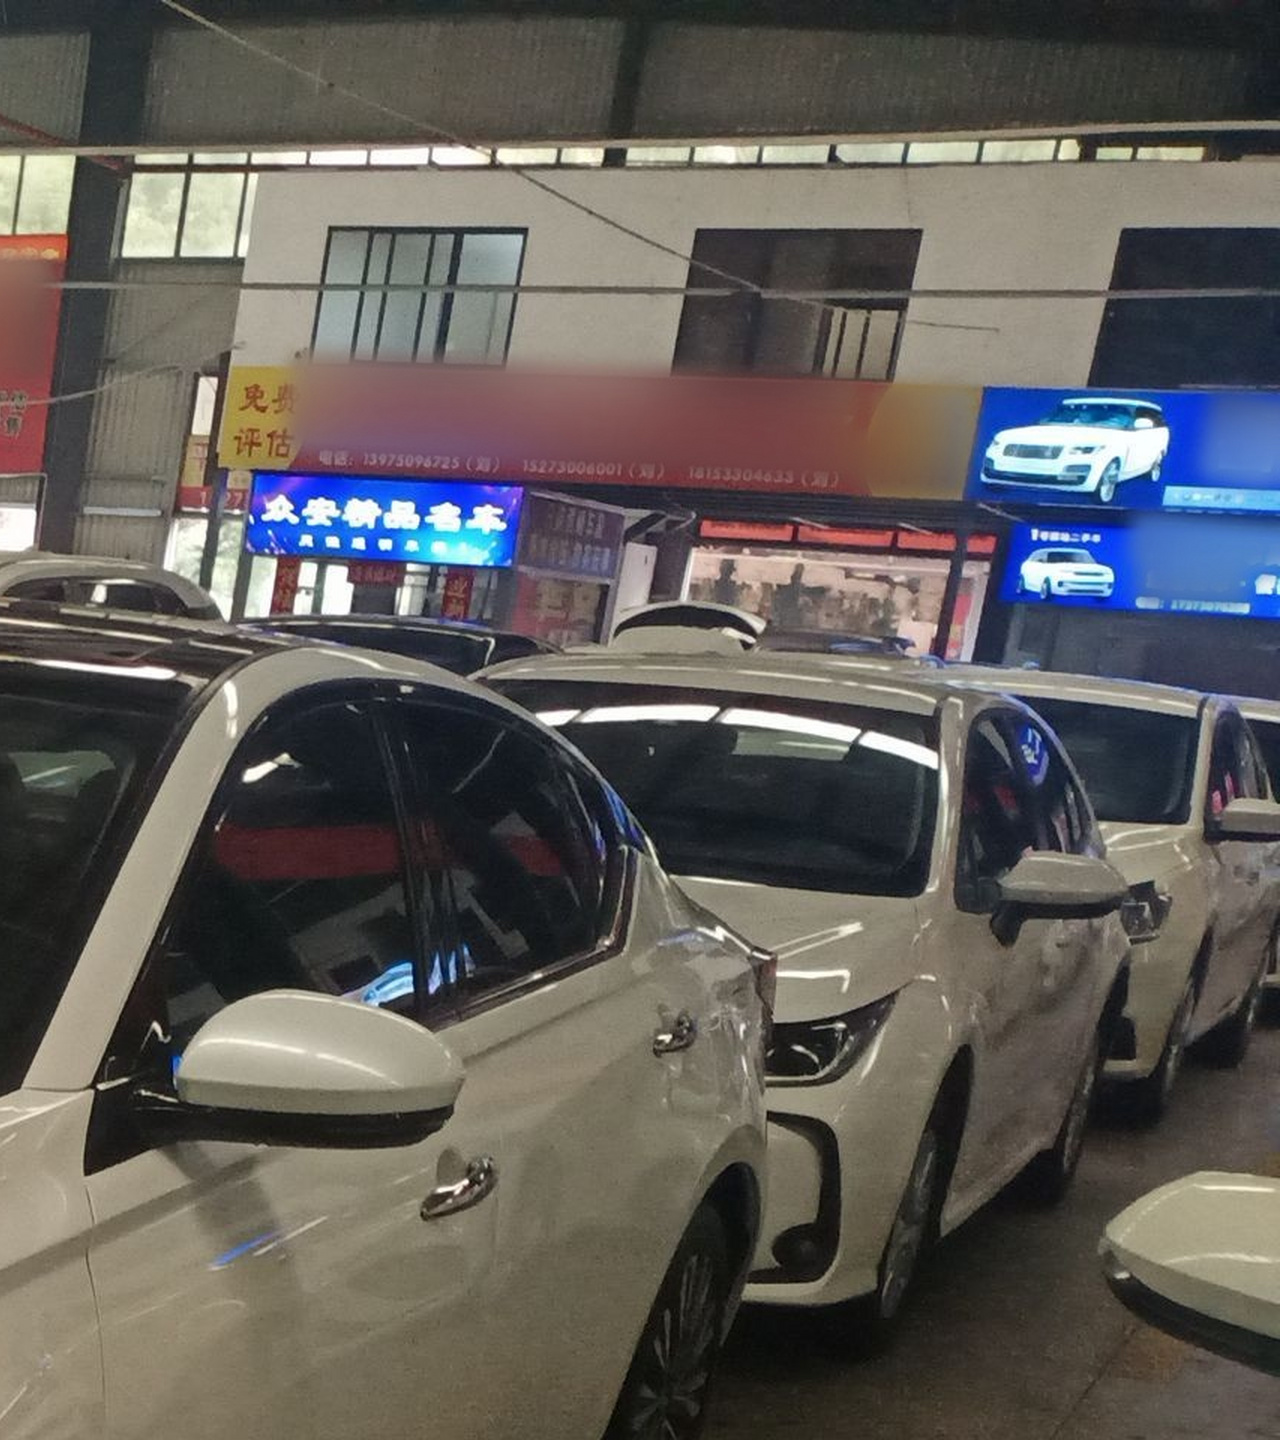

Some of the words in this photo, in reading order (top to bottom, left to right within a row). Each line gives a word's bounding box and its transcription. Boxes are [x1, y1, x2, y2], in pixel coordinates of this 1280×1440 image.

[234, 427, 295, 458] 评估
[260, 494, 508, 536] 众安精品名车
